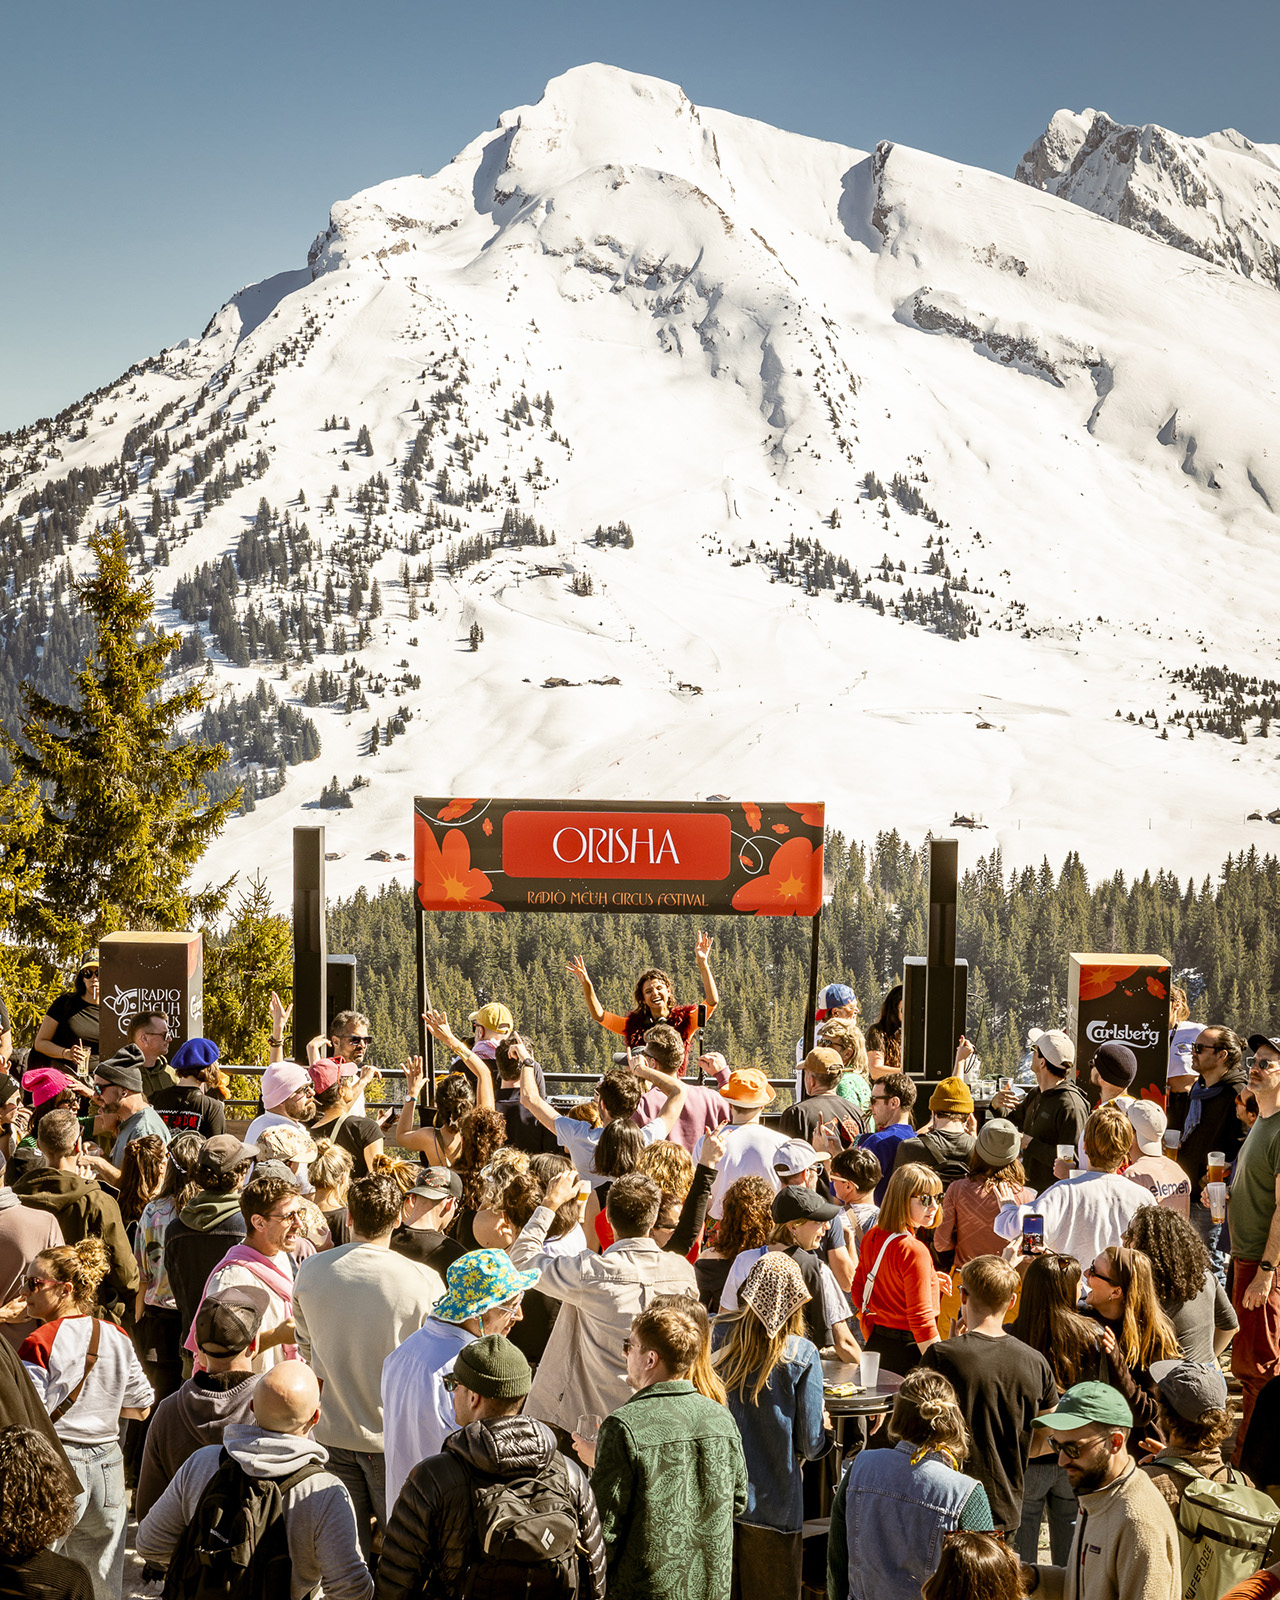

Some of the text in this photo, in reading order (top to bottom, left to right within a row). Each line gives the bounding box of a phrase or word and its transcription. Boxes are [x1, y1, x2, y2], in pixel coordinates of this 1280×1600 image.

[552, 826, 680, 864] ORISHA
[527, 891, 709, 907] RADIO MEUH CIRCUS FESTIVAL
[141, 988, 181, 1001] RADIO
[1086, 1020, 1160, 1046] Carlsberg
